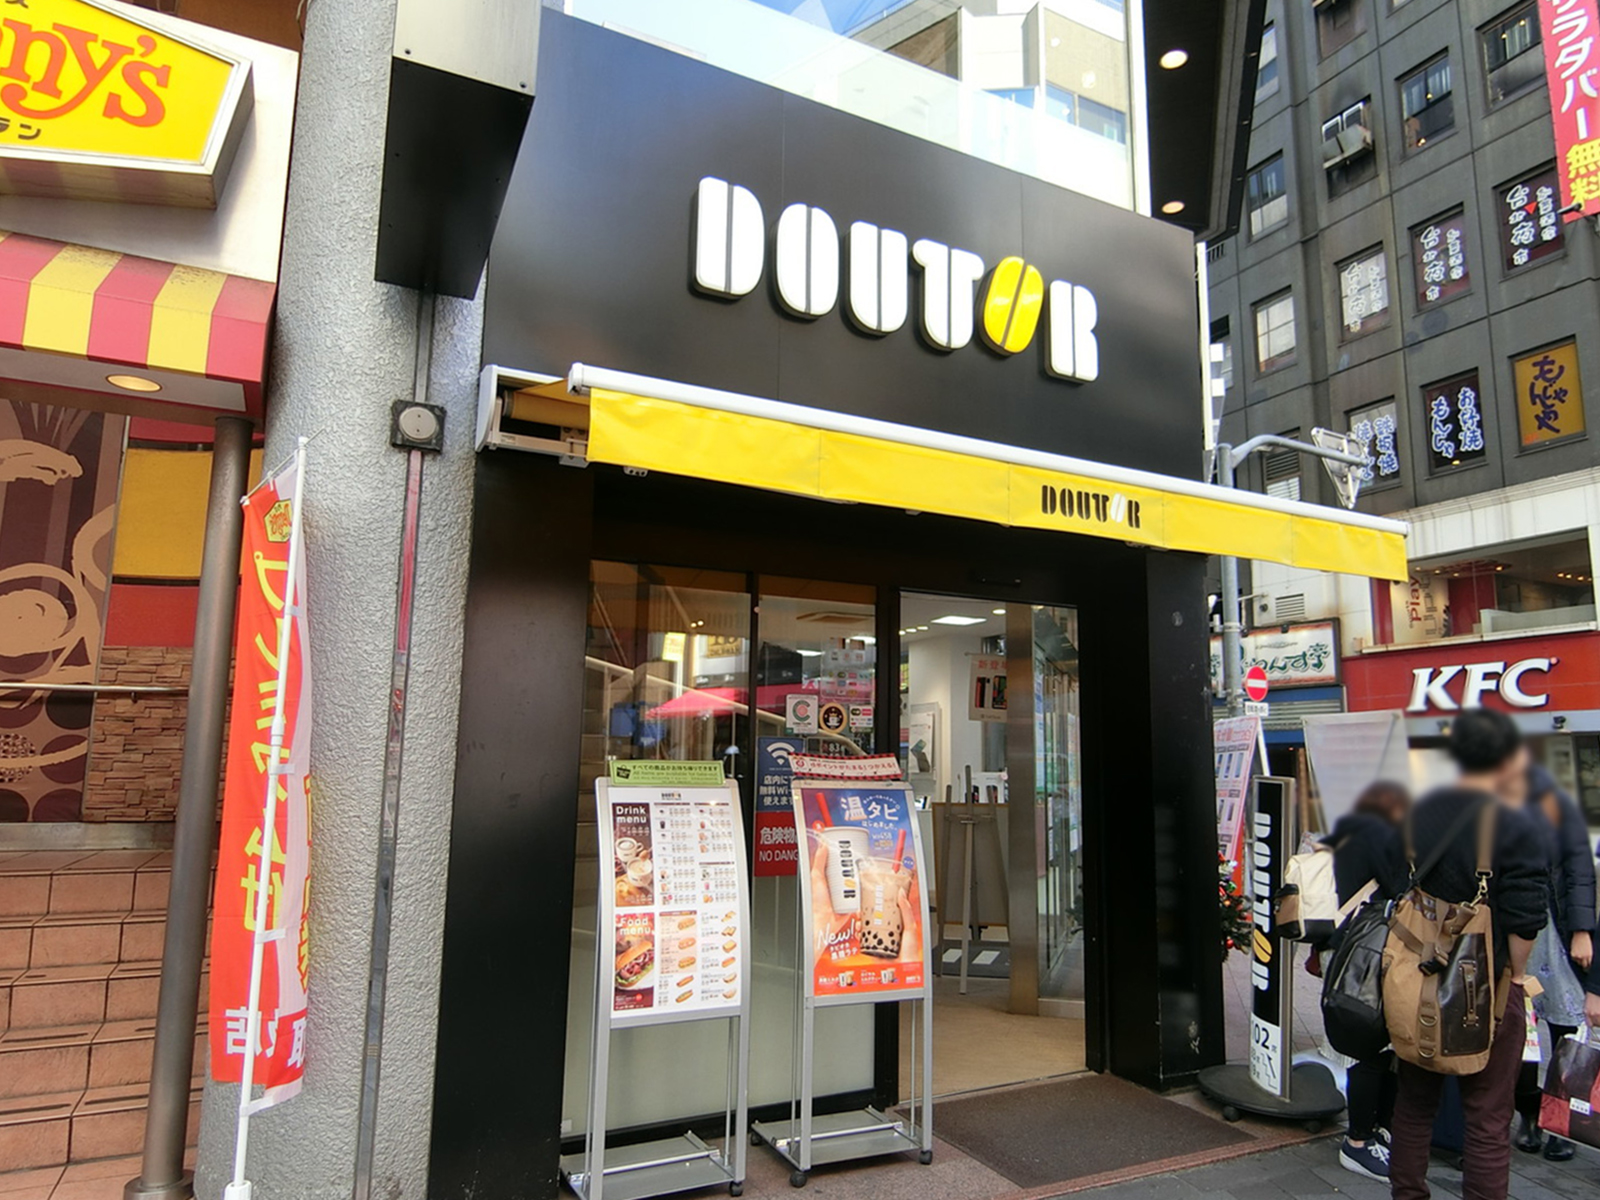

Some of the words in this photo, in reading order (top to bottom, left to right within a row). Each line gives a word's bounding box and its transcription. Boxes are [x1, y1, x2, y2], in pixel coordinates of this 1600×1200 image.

[0, 18, 171, 127] ny's
[694, 176, 1099, 384] DOUTOR
[1432, 396, 1455, 458] もんじゃ
[1041, 485, 1140, 529] DOUTOR
[1406, 658, 1550, 712] KFC
[616, 806, 646, 815] Drink
[616, 815, 647, 824] menu
[760, 827, 798, 845] 危険物
[759, 850, 773, 862] NO
[1252, 812, 1272, 991] DOUTOR
[620, 917, 649, 926] Food
[620, 926, 651, 936] menu
[817, 918, 855, 950] New!
